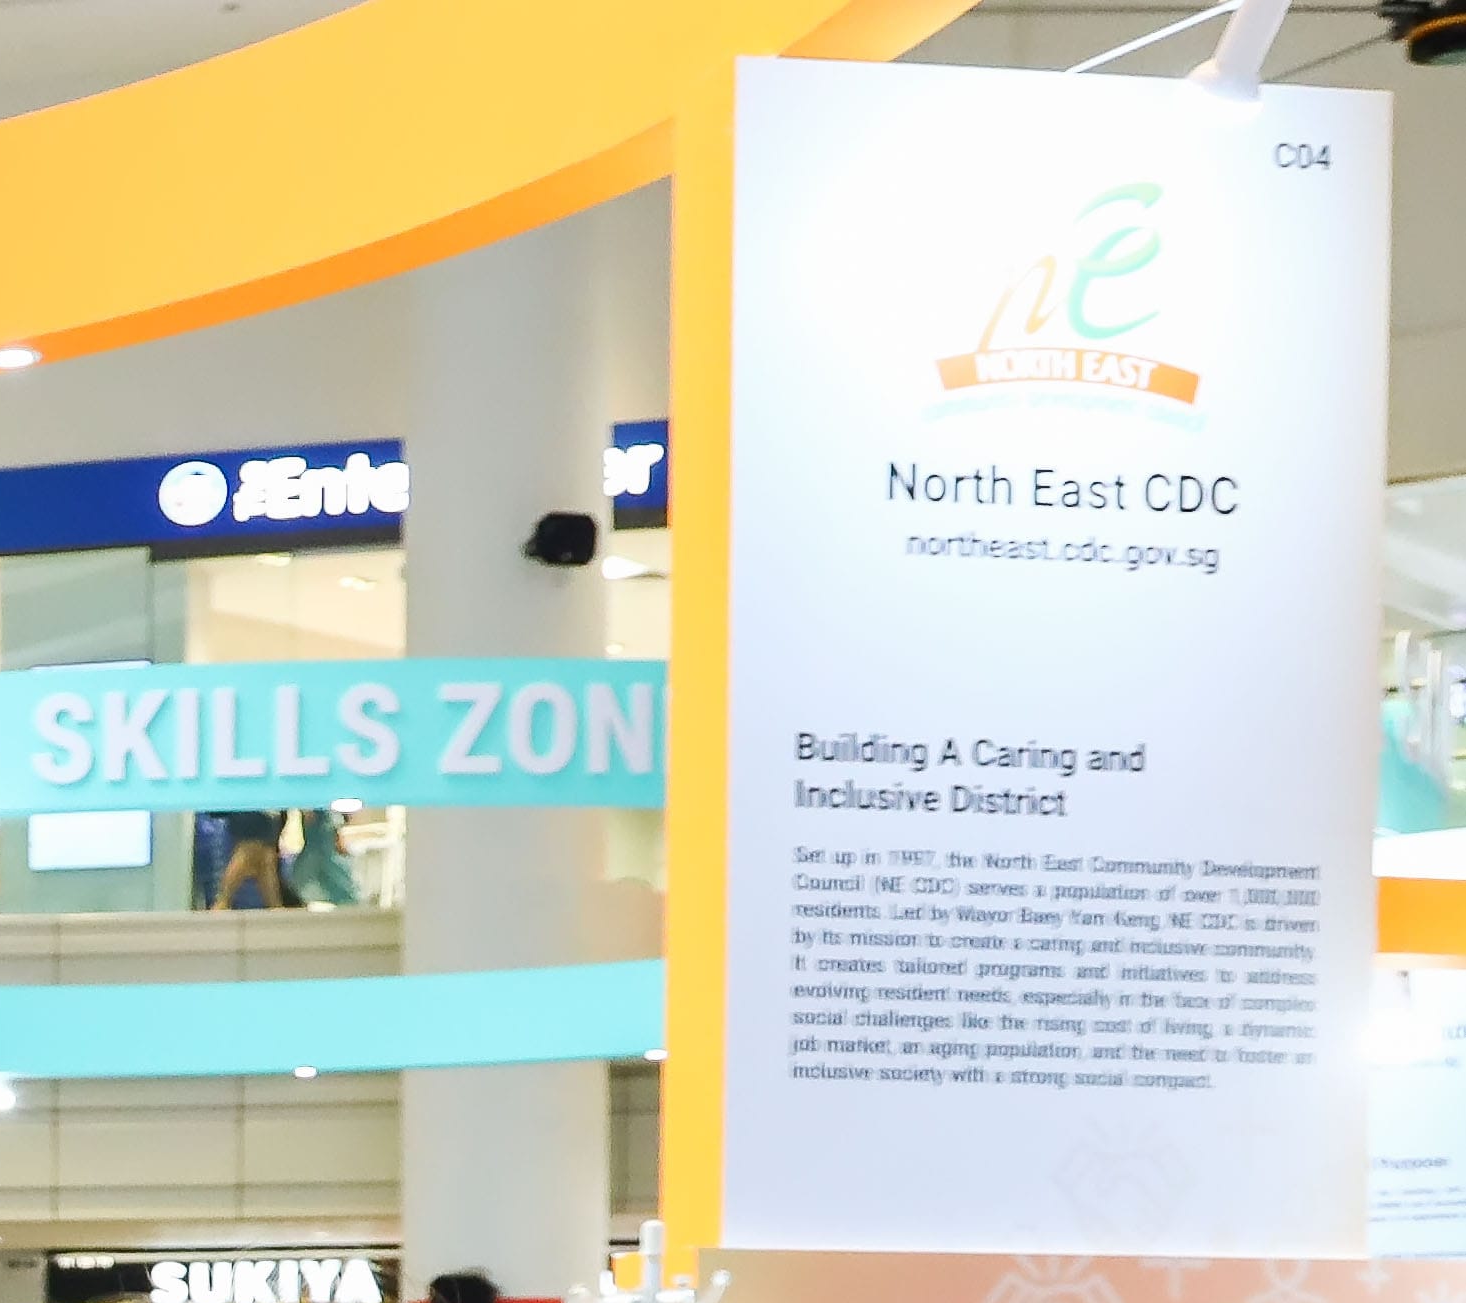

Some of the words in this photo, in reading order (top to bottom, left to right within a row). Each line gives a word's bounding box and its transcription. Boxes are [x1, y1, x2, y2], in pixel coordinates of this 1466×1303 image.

[1274, 142, 1332, 171] C04
[975, 350, 1077, 382] NORTH
[1082, 351, 1153, 391] EAST
[888, 461, 1013, 506] North
[1032, 467, 1127, 511] East
[1144, 473, 1239, 517] CDC
[906, 532, 1221, 576] northeast.cdc.gov.sg
[33, 682, 400, 786] SKILLS
[438, 680, 667, 776] ZON
[794, 732, 929, 773] Building
[937, 737, 962, 766] A
[971, 738, 1078, 778] Caring
[1086, 742, 1146, 773] and
[794, 779, 941, 813] Inclusive
[949, 784, 1068, 818] District
